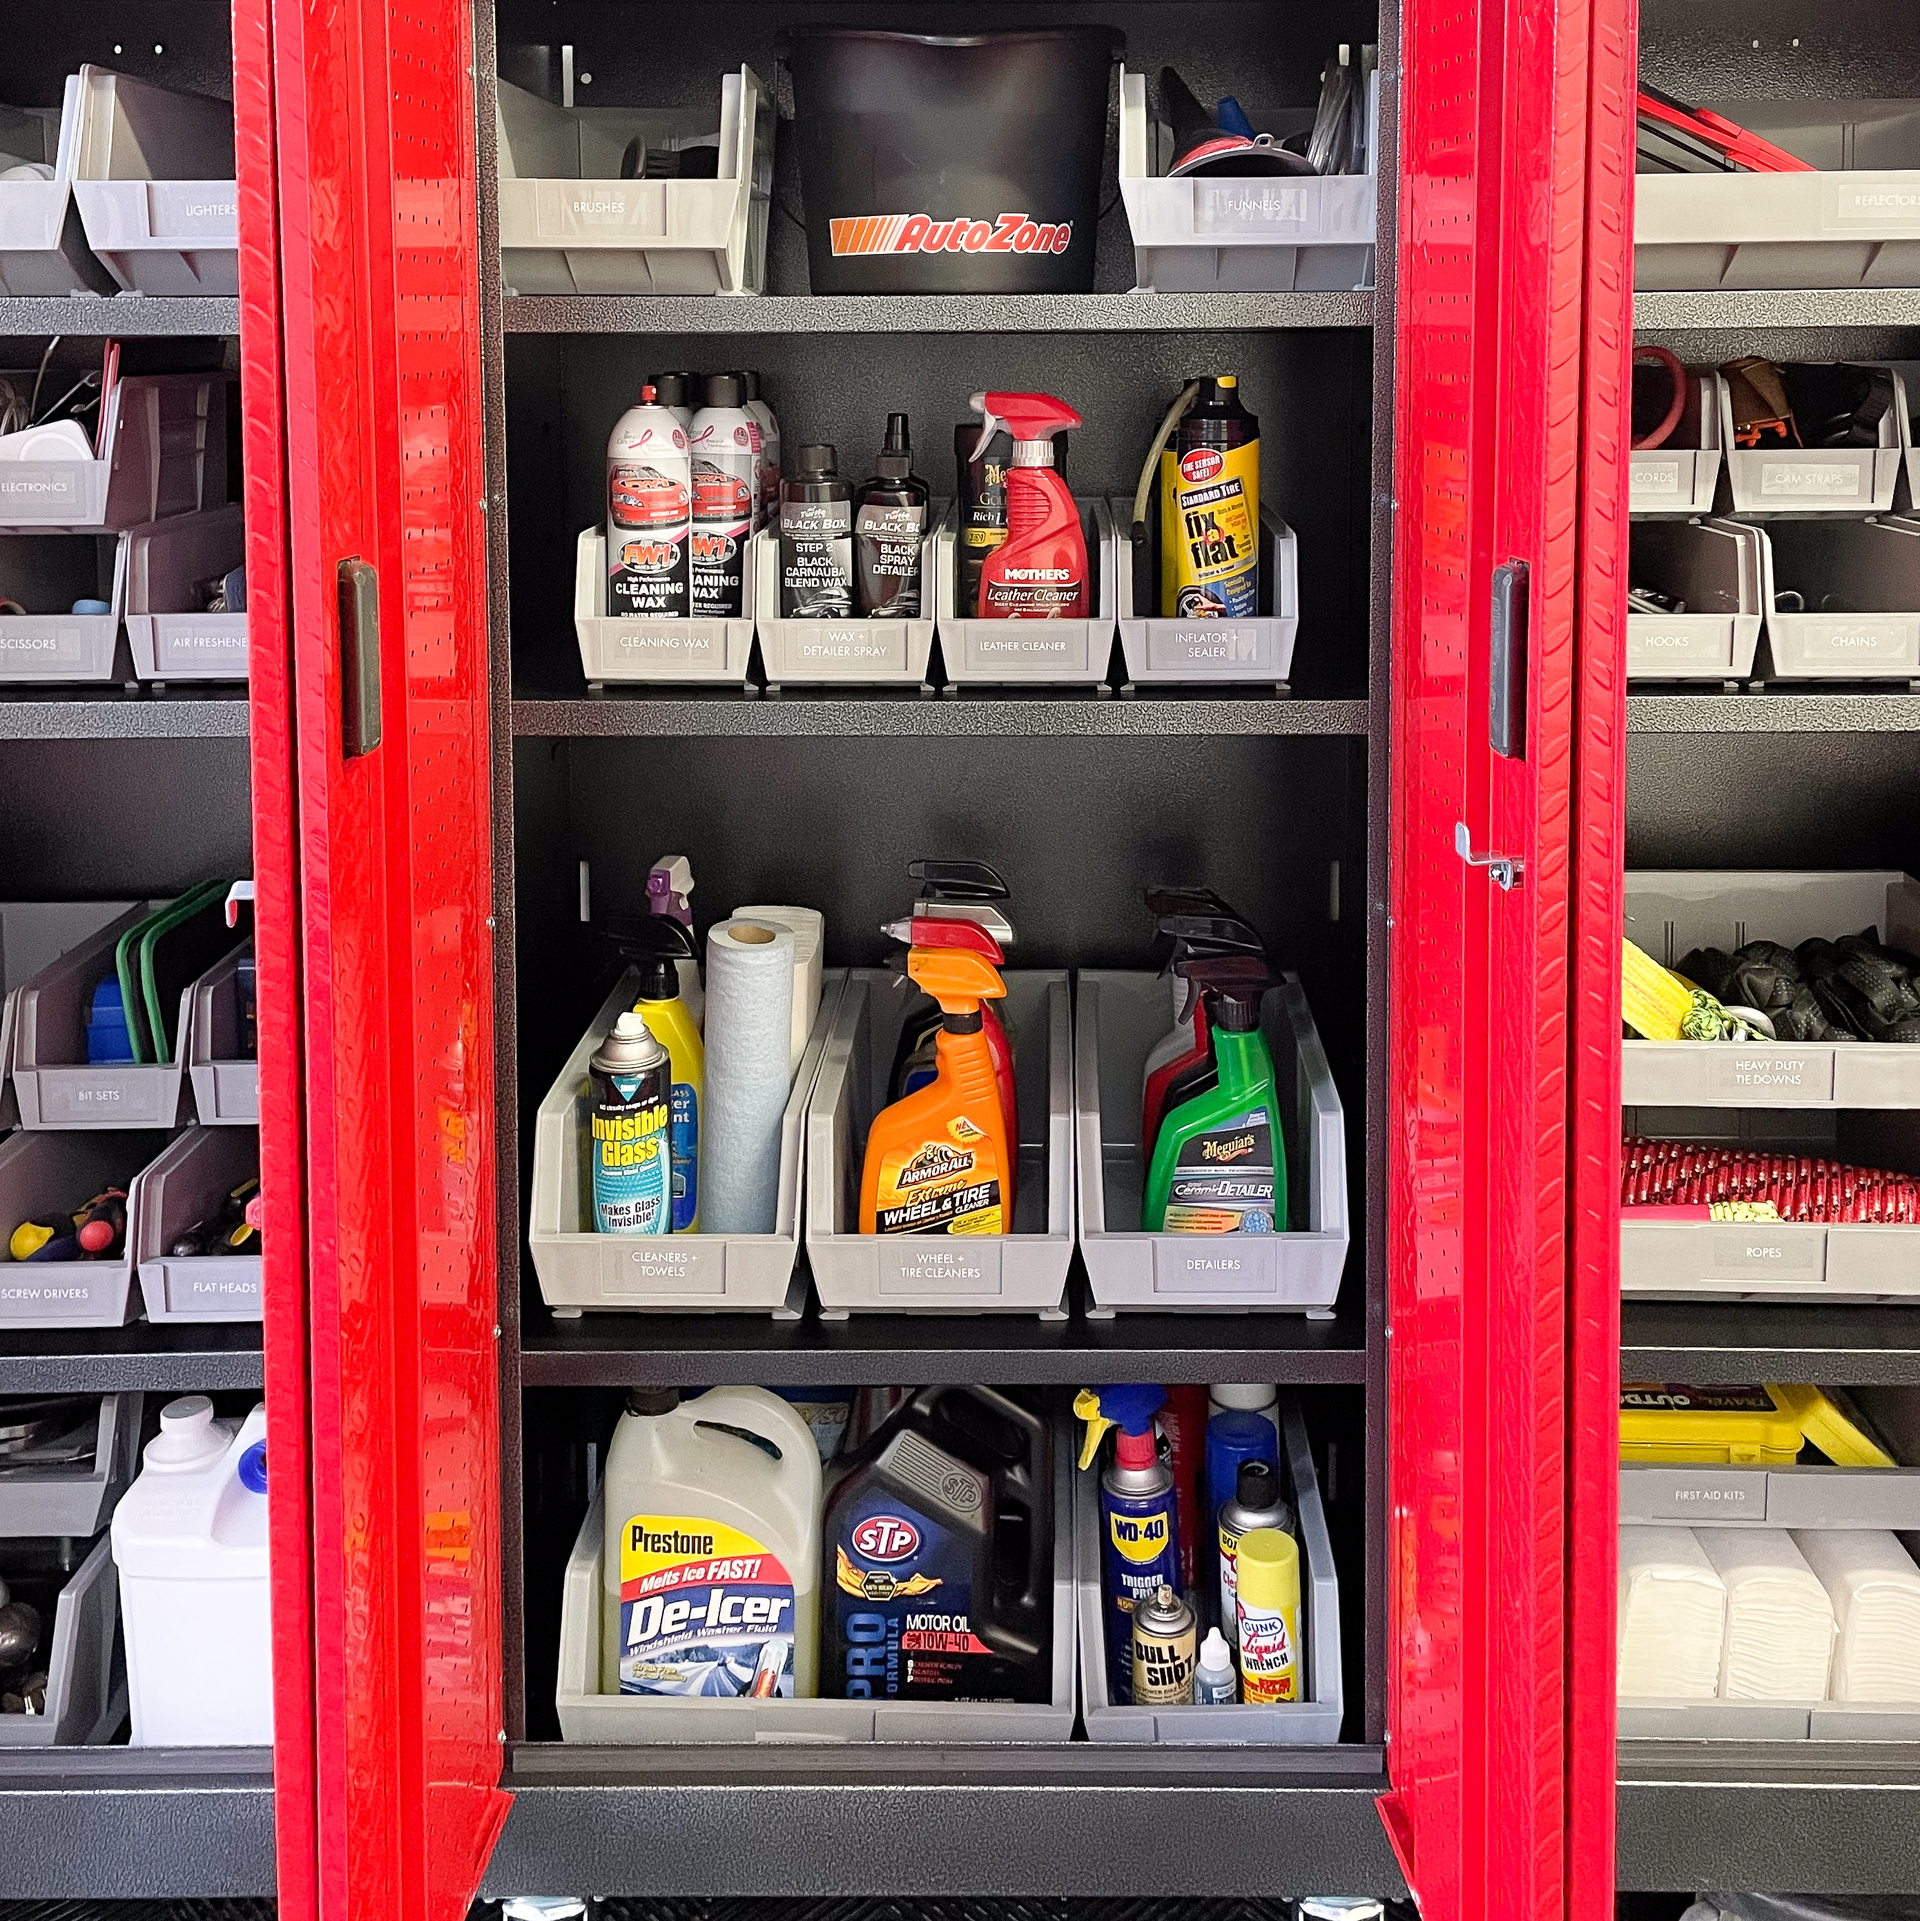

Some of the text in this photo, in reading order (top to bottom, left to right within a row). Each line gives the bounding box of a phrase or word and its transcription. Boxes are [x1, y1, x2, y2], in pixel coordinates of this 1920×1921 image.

[185, 203, 237, 217] LIGHTERS
[573, 201, 625, 213] BRUSHES
[1227, 199, 1281, 211] FUNNELS
[901, 212, 1072, 255] AutoZone
[1195, 457, 1221, 471] SENSOR
[1634, 472, 1674, 483] CORDS
[1774, 473, 1844, 485] CAM STRAPS
[1, 482, 68, 492] ELECTRONICS
[1180, 488, 1220, 509] STANDARD
[1219, 481, 1241, 499] TIRE
[973, 511, 994, 522] Rich
[783, 518, 847, 530] BLACK BOX
[864, 520, 902, 532] BLACK
[1184, 508, 1218, 540] fix
[623, 543, 673, 565] FW1
[795, 542, 834, 553] STEP 2
[880, 543, 916, 556] BLACK
[1190, 531, 1240, 569] flat
[797, 556, 834, 567] BLACK
[879, 554, 916, 566] SPRAY
[785, 566, 846, 577] CARNAUBA
[1004, 568, 1071, 581] MOTHERS
[692, 574, 740, 587] ANING
[784, 577, 847, 588] BLEND WAX
[615, 582, 684, 595] CLEANING
[987, 588, 1079, 602] Leather Cleaner
[631, 596, 667, 608] WAX
[173, 637, 191, 648] AIR
[620, 636, 710, 649] CLEANING WAX
[828, 631, 856, 642] WAX
[1175, 632, 1228, 644] INFLATOR
[1645, 635, 1689, 647] HOOKS
[1830, 635, 1878, 647] CHAINS
[0, 638, 57, 650] SCISSORS
[980, 641, 1067, 651] LEATHER CLEANER
[803, 645, 887, 657] DETAILER SPRAY
[1188, 646, 1226, 658] SEALER
[1735, 1060, 1806, 1071] HEAVY DUTY
[1735, 1074, 1802, 1085] TIE DOWNS
[78, 1090, 120, 1101] BIT SETS
[591, 1103, 669, 1142] Invisible
[601, 1137, 659, 1167] Glass
[1201, 1133, 1256, 1161] Meguiar's
[905, 1178, 968, 1208] Extreme
[1174, 1180, 1273, 1198] Ceramic DETAILER
[600, 1195, 661, 1217] Makes Glass
[884, 1202, 941, 1227] WHEEL
[953, 1183, 991, 1206] TIRE
[954, 1198, 990, 1215] CLEANER
[607, 1208, 655, 1228] Invisible!
[631, 1251, 688, 1263] CLEANERS
[917, 1253, 955, 1264] WHEEL
[1746, 1247, 1782, 1259] ROPES
[641, 1265, 685, 1277] TOWELS
[1186, 1259, 1241, 1270] DETAILERS
[901, 1267, 981, 1279] TIRE CLEANERS
[1, 1288, 89, 1299] SCREW DRIVERS
[193, 1282, 257, 1294] FLAT HEADS
[943, 1477, 977, 1504] STP
[1675, 1490, 1745, 1501] FIRST AID KITS
[1114, 1519, 1164, 1542] WD-40
[631, 1524, 714, 1555] Prestone
[858, 1520, 913, 1555] STP
[639, 1558, 762, 1595] Melts Ice FAST!
[1121, 1573, 1164, 1589] TRIGGER
[626, 1587, 792, 1647] De-Icer
[905, 1614, 971, 1633] MOTOR OIL
[1244, 1618, 1279, 1633] GUNK
[628, 1623, 779, 1658] Windshield Washer Fluid
[922, 1632, 970, 1652] 10W-40
[1241, 1631, 1287, 1663] Liquid
[1243, 1652, 1289, 1671] WRENCH
[1146, 1653, 1193, 1686] SHOT
